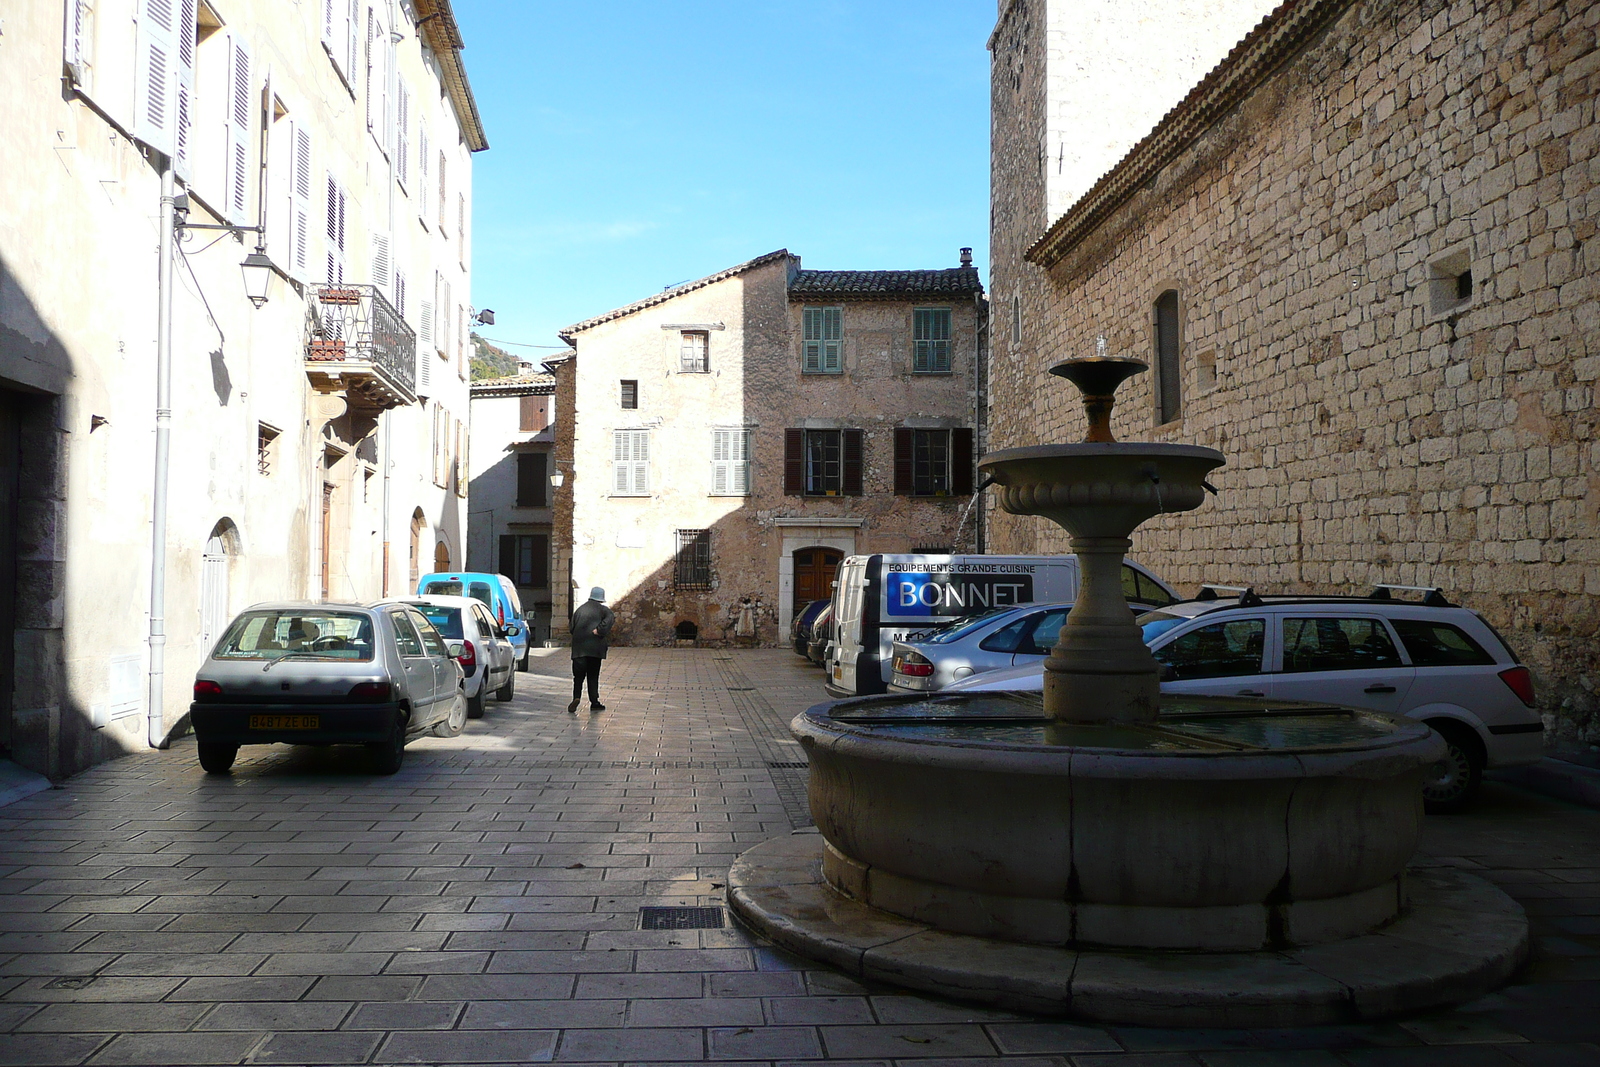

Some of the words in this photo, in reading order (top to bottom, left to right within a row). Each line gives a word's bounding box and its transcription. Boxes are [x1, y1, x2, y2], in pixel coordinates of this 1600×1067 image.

[889, 564, 955, 573] EQUIPEMENTS
[957, 564, 998, 573] GRANDE
[1000, 565, 1036, 574] CUISINE
[900, 582, 1025, 607] BONNET
[251, 716, 282, 728] 8487
[285, 716, 299, 728] ZE
[302, 716, 318, 728] 06
